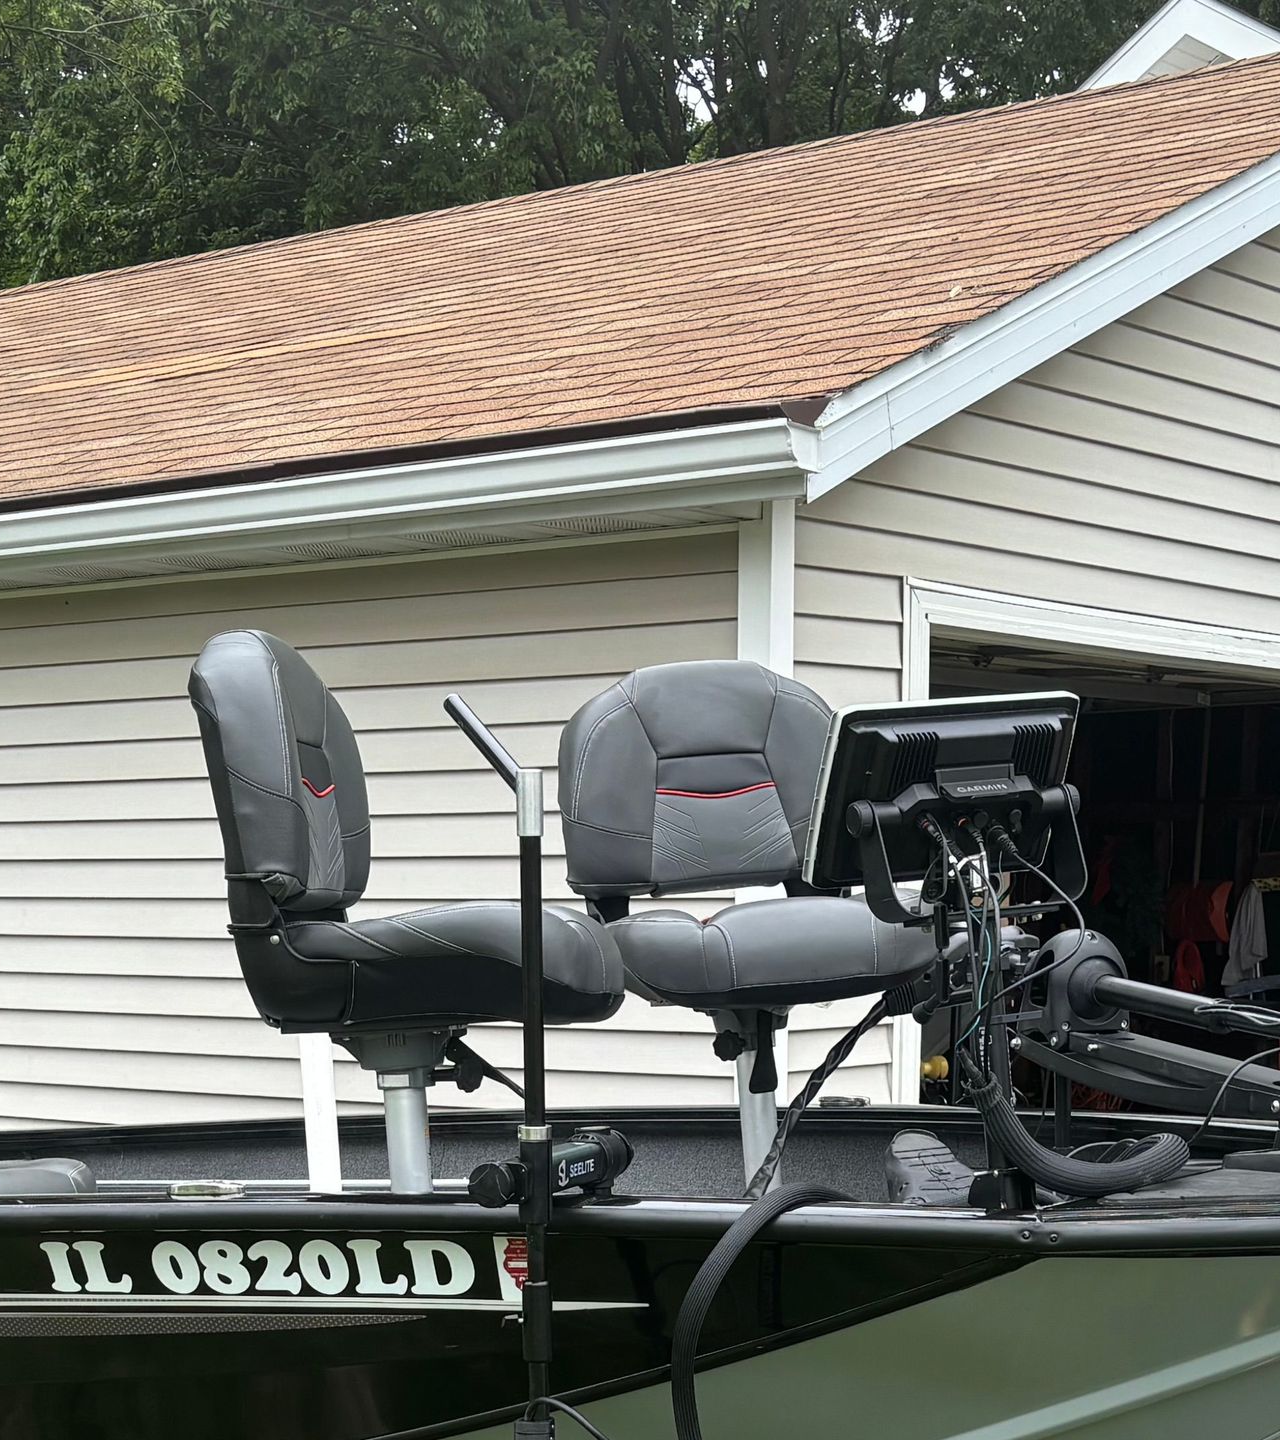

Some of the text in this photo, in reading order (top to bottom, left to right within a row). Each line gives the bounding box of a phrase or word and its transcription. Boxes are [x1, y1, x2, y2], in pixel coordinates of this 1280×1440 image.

[569, 1158, 595, 1178] SEELITE
[39, 1241, 133, 1293] IL
[151, 1239, 476, 1296] 0820LD
